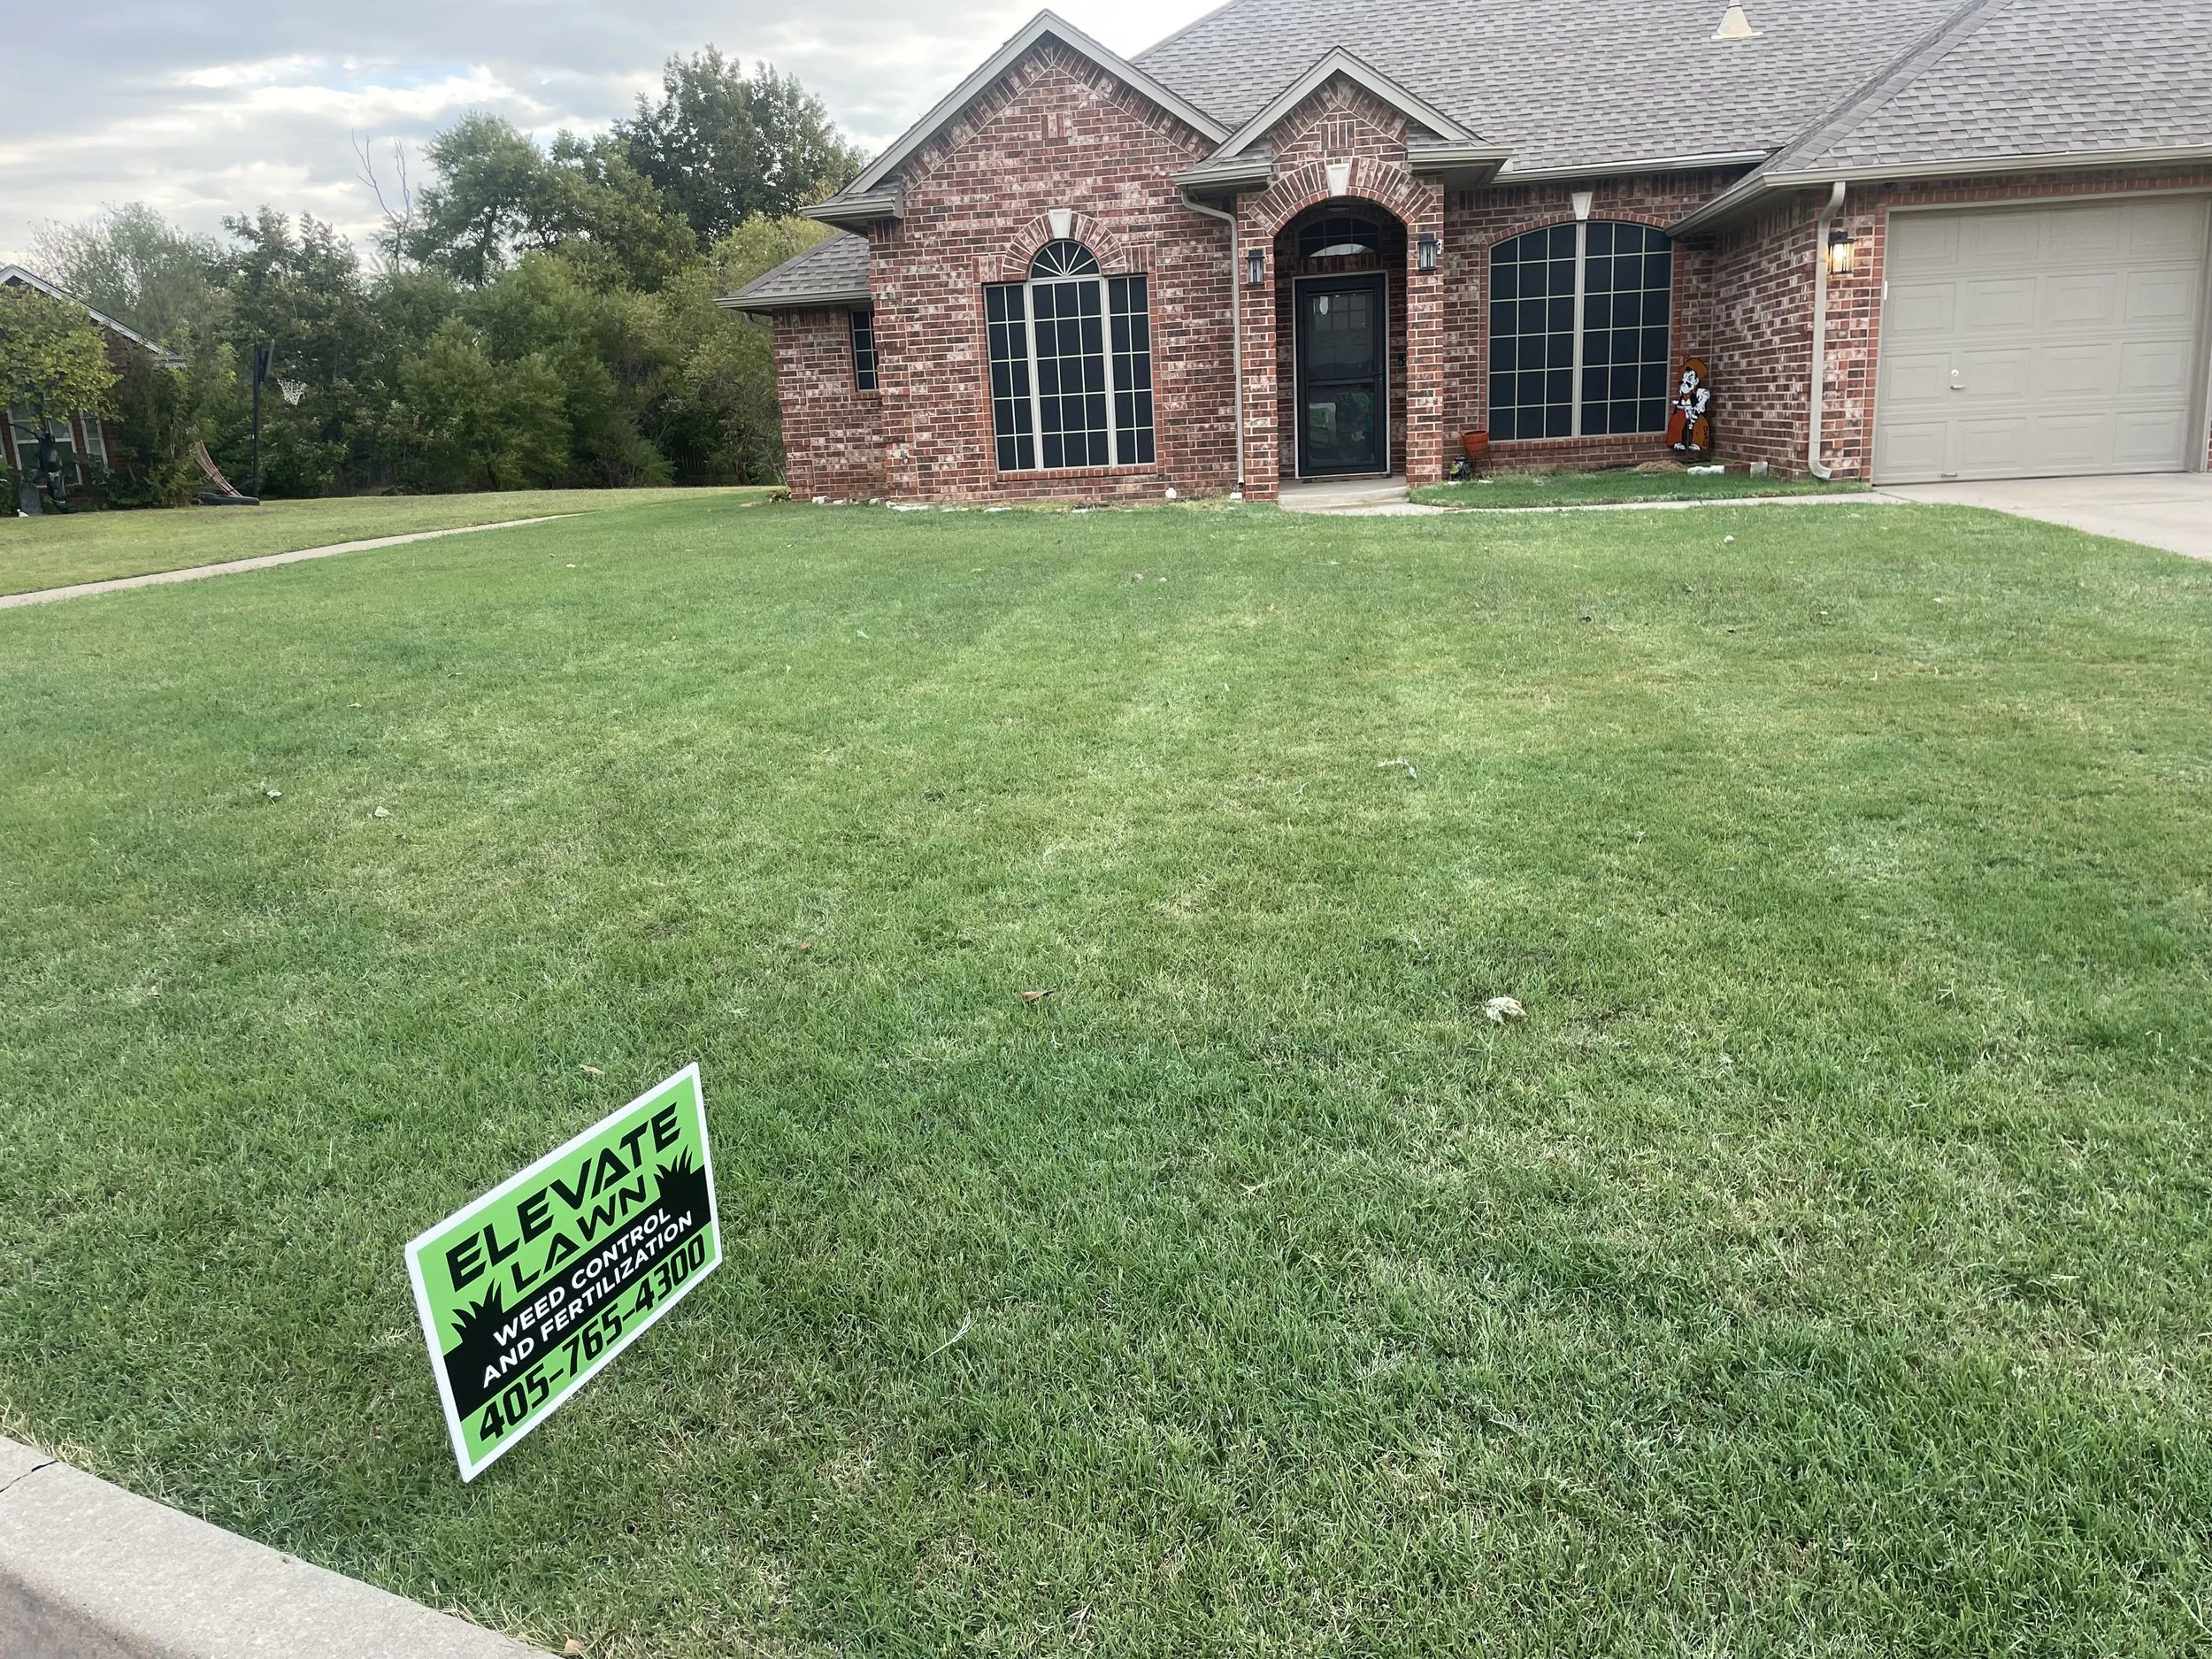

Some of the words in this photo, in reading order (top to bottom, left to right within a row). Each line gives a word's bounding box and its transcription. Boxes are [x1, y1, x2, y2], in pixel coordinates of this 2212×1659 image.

[445, 1102, 681, 1293] ELEVATE
[493, 1286, 565, 1347] WEED
[572, 1209, 672, 1289] CONTROL
[510, 1173, 647, 1294] LAWN
[480, 1233, 705, 1442] 405-765-4300
[482, 1337, 534, 1389] AND
[541, 1210, 693, 1342] FERTILIZATION
